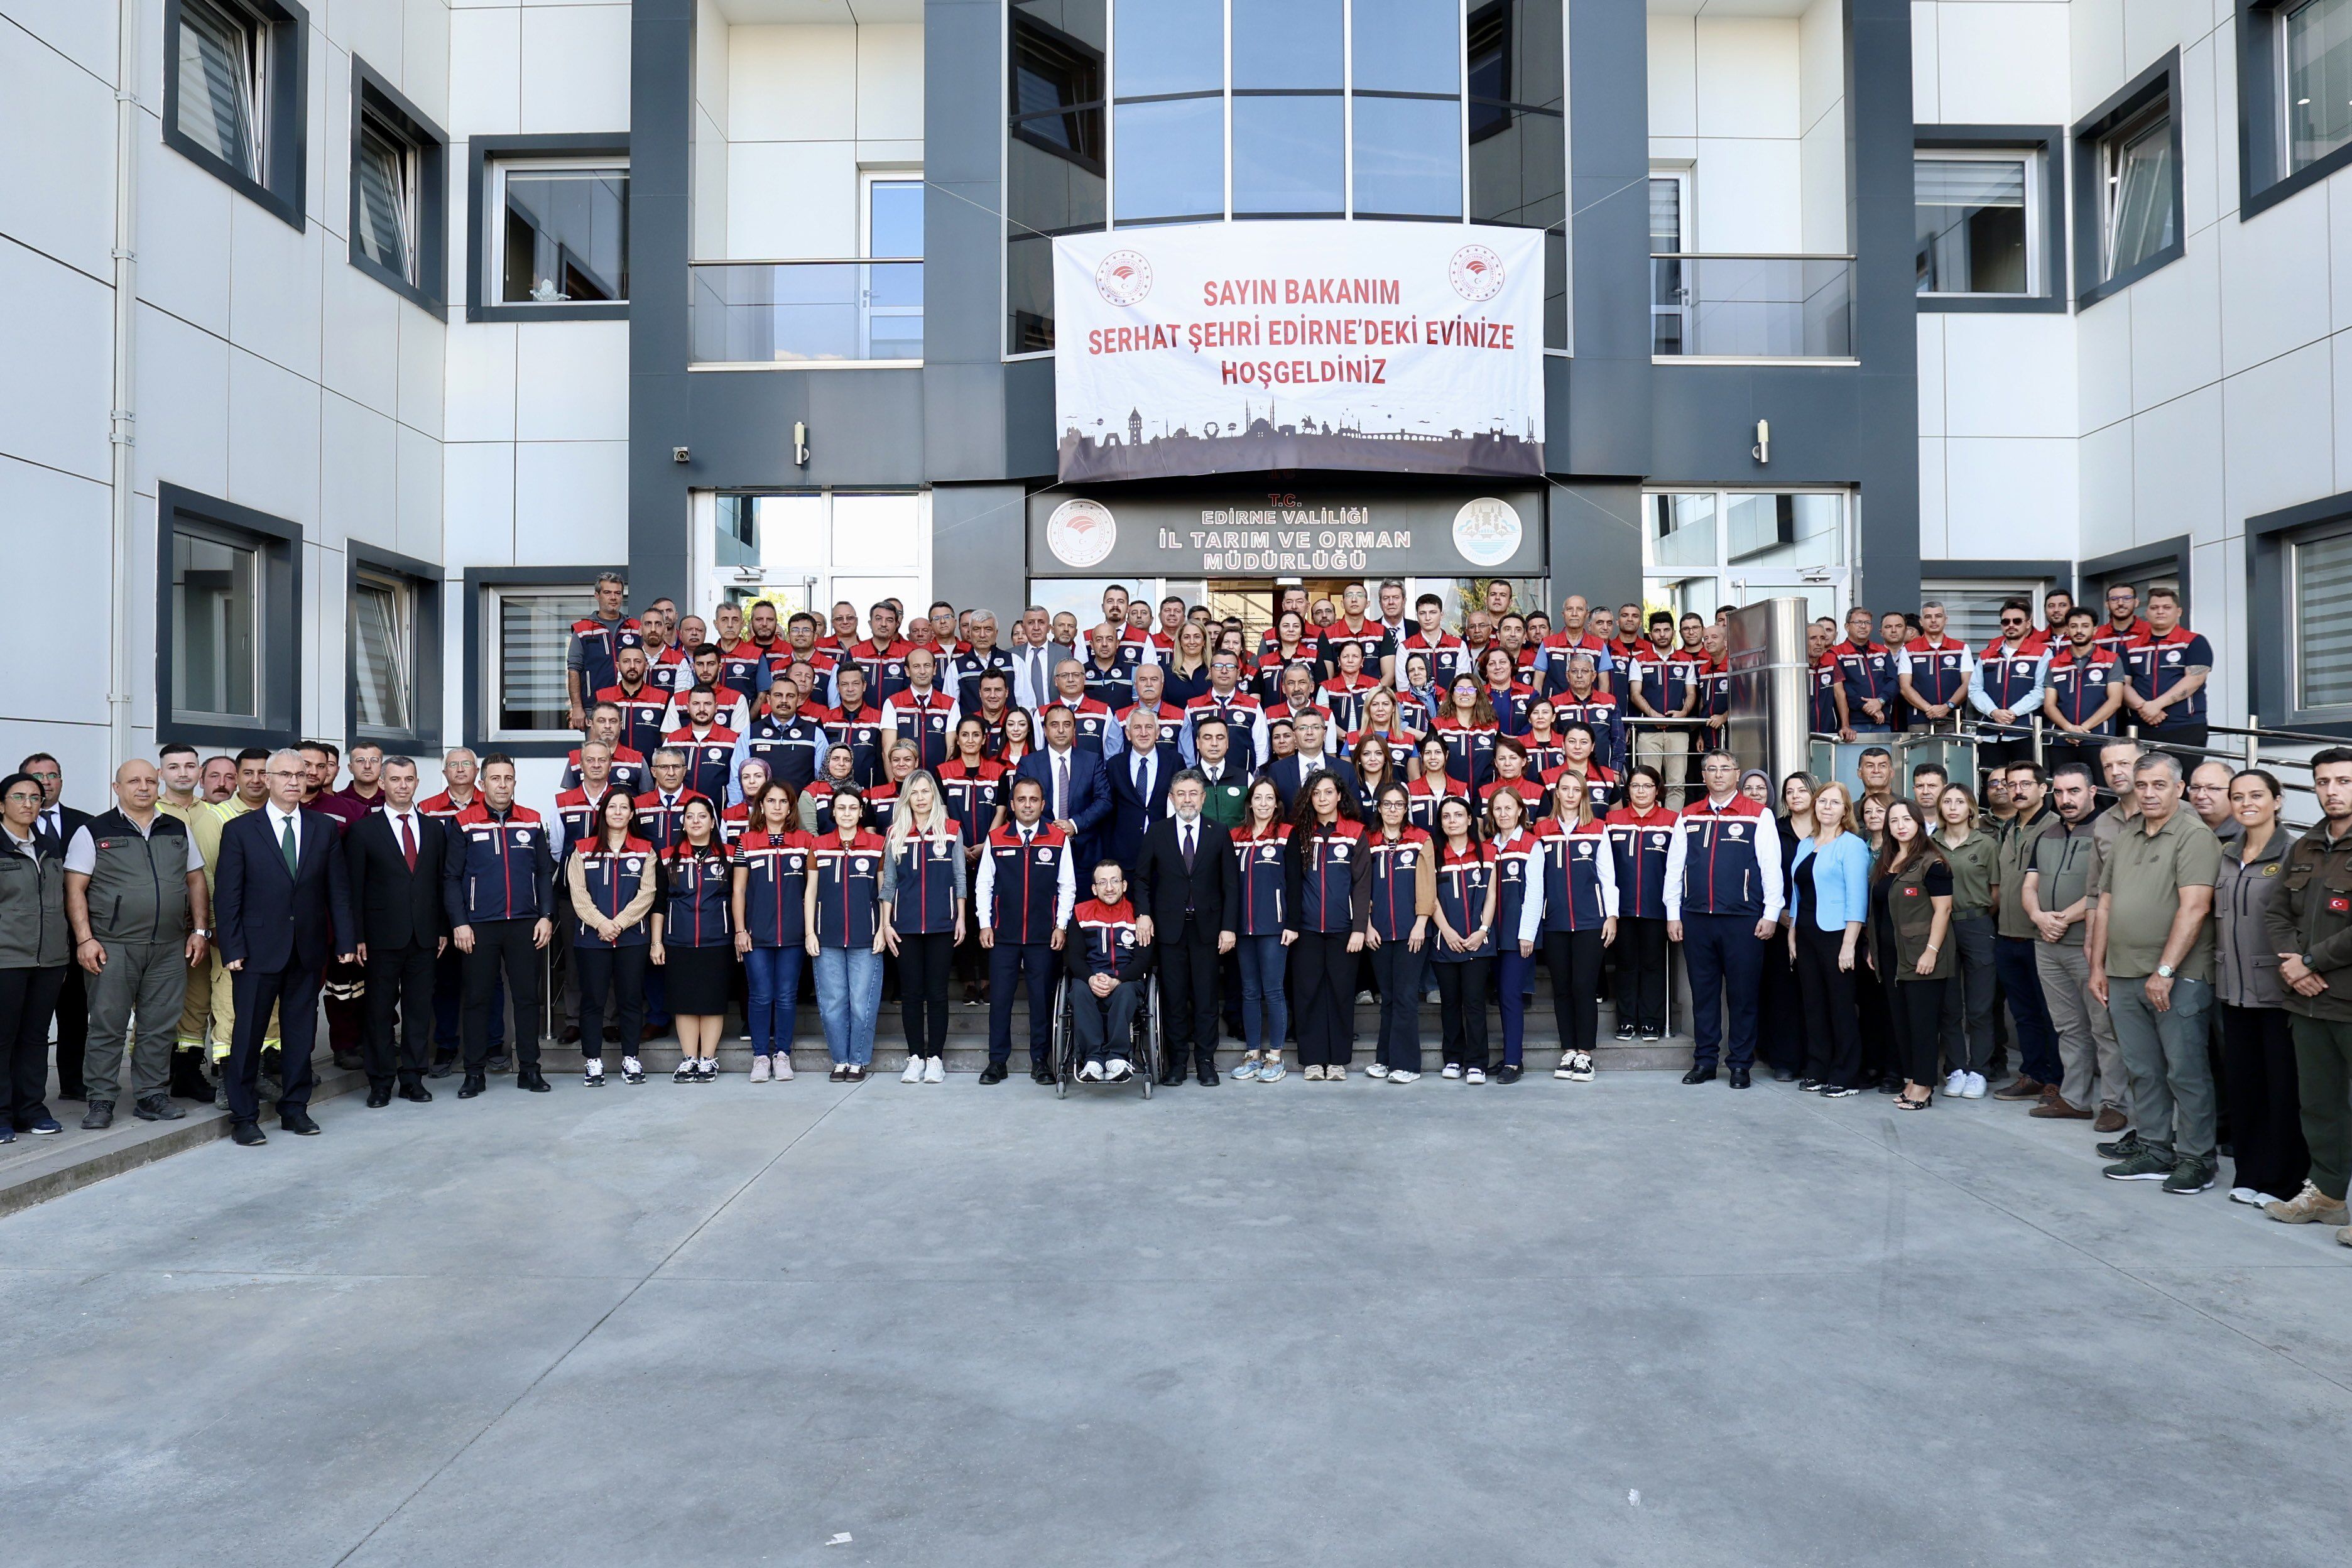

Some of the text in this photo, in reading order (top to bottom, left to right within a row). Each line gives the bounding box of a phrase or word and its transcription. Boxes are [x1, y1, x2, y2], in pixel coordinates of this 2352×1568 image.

[1204, 279, 1400, 307] SAYIN BAKANIM
[1089, 324, 1181, 356] SERHAT
[1189, 314, 1260, 353] ŞEHRİ
[1427, 314, 1515, 350] EVİNİZE
[1222, 354, 1387, 389] HOŞGELDİNİZ
[1268, 493, 1302, 508] T.C.
[1202, 507, 1368, 525] EDİRNE VALİLİĞİ
[1159, 528, 1411, 548] İL TARIM VE ORMAN
[1204, 549, 1366, 570] MÜDÜRLÜĞÜ
